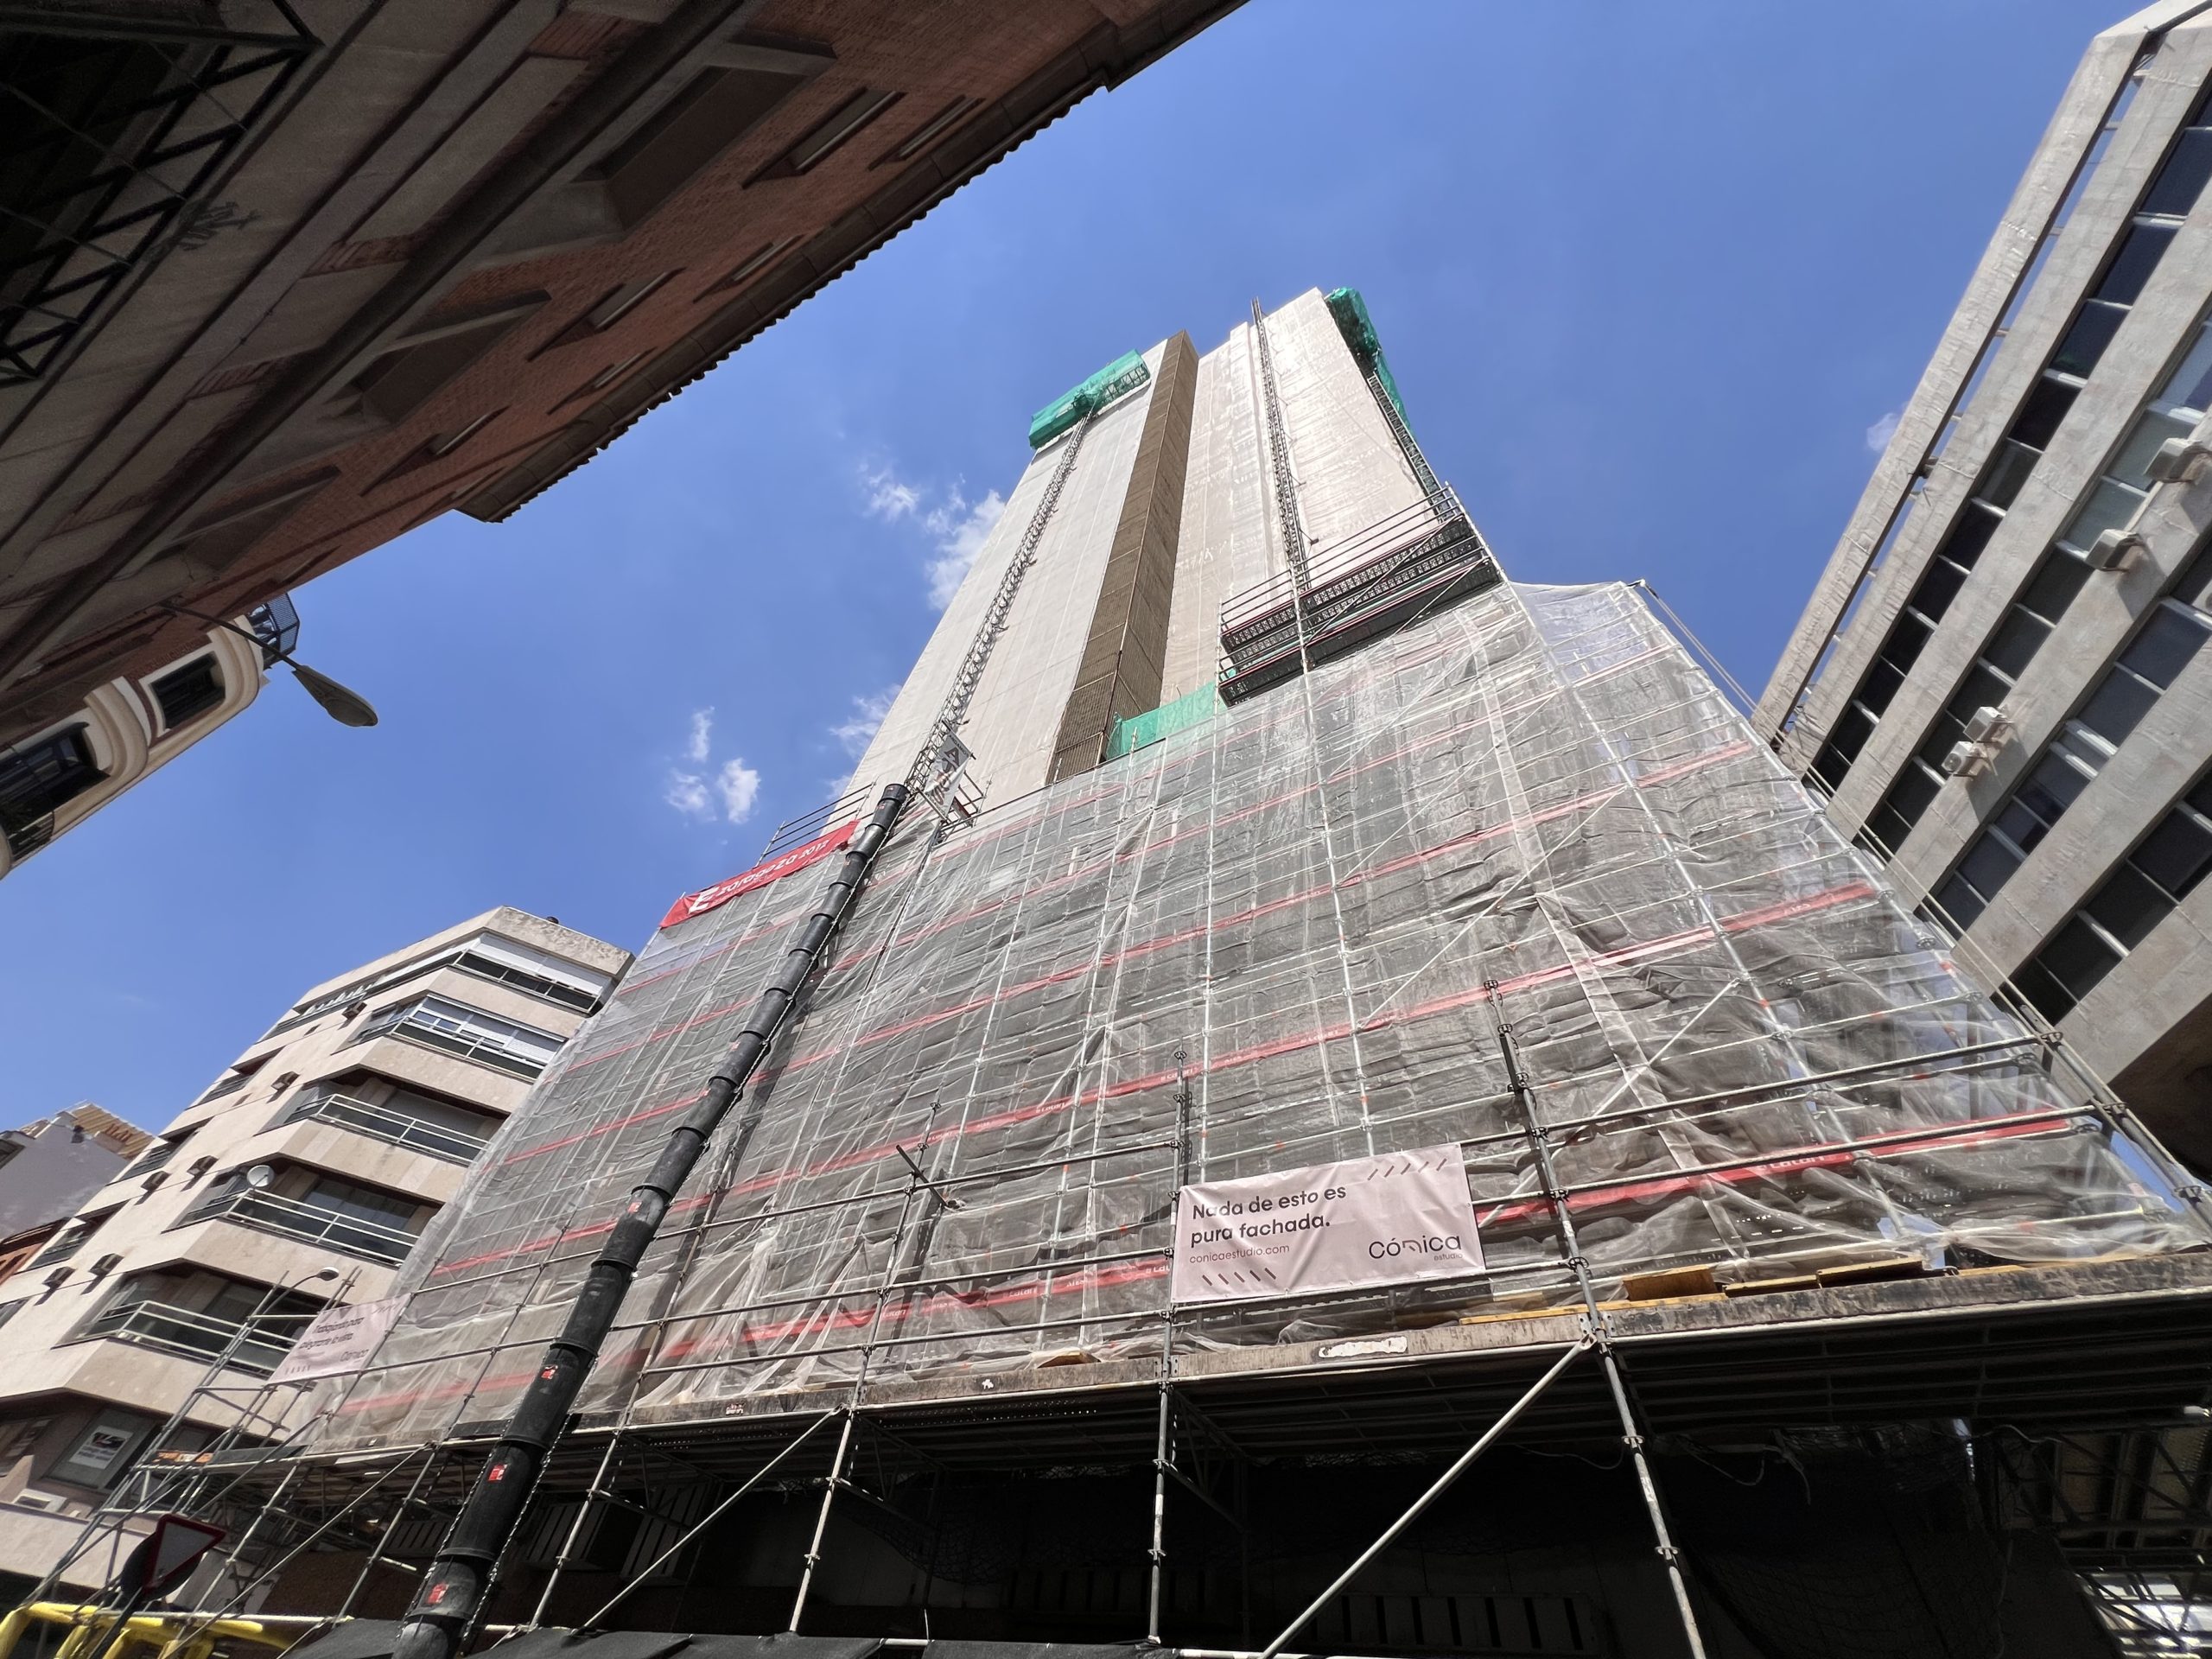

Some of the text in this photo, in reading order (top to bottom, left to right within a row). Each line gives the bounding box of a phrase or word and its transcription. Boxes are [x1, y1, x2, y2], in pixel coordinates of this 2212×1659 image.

[1192, 1185, 1347, 1220] Nada de esto es
[1190, 1213, 1332, 1248] pura fachada.
[1189, 1243, 1291, 1264] conicaestudio.com
[1368, 1234, 1462, 1261] Cónica
[1433, 1252, 1464, 1262] estudio
